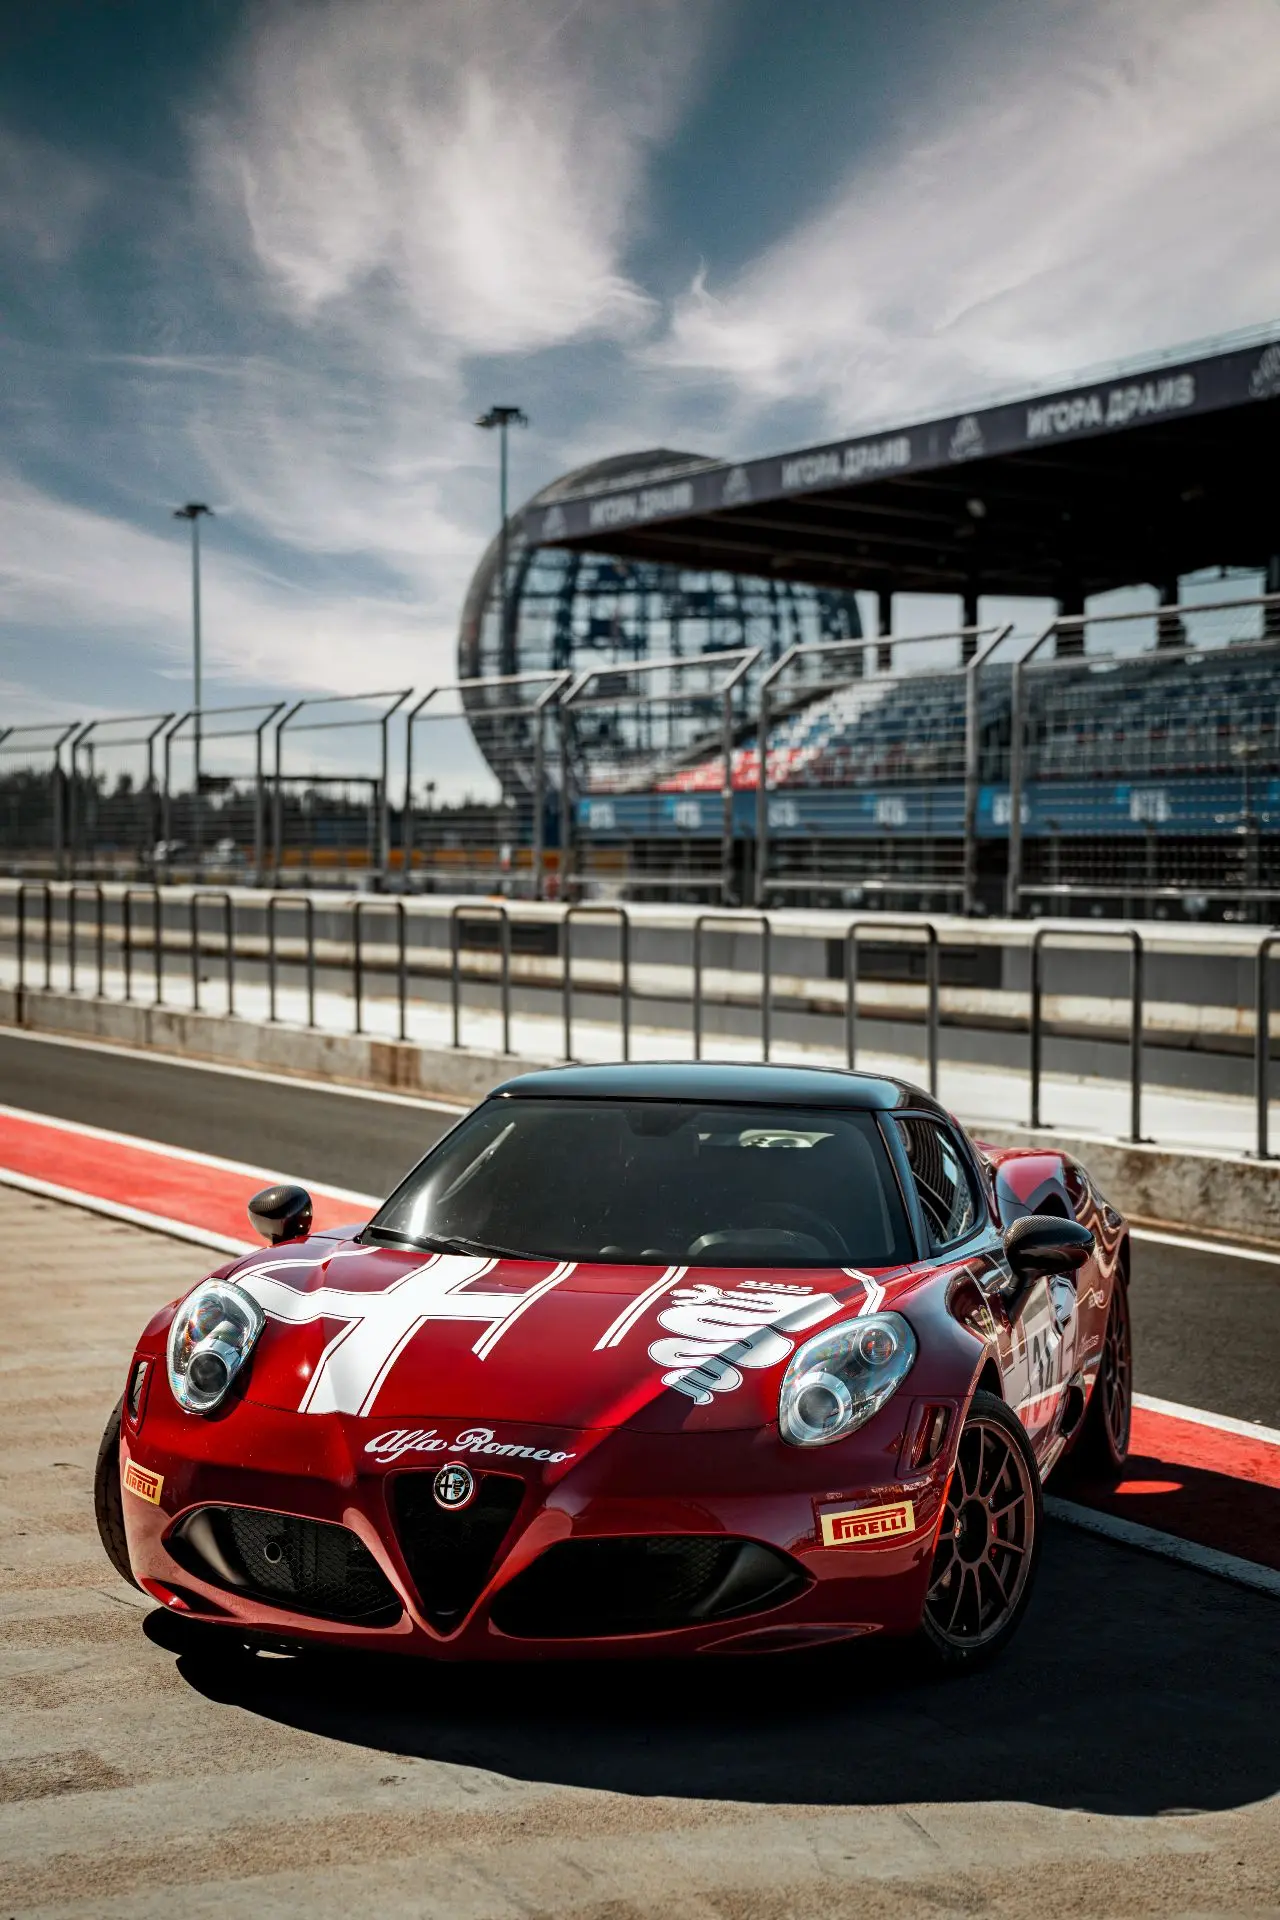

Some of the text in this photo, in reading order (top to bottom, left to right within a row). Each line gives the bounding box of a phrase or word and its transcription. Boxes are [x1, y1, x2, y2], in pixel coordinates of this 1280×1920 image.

[1027, 393, 1103, 440] ИГОРА
[364, 1427, 576, 1464] Alfa Romeo
[126, 1465, 159, 1499] PIRELLI
[832, 1506, 907, 1541] PIRELLI
